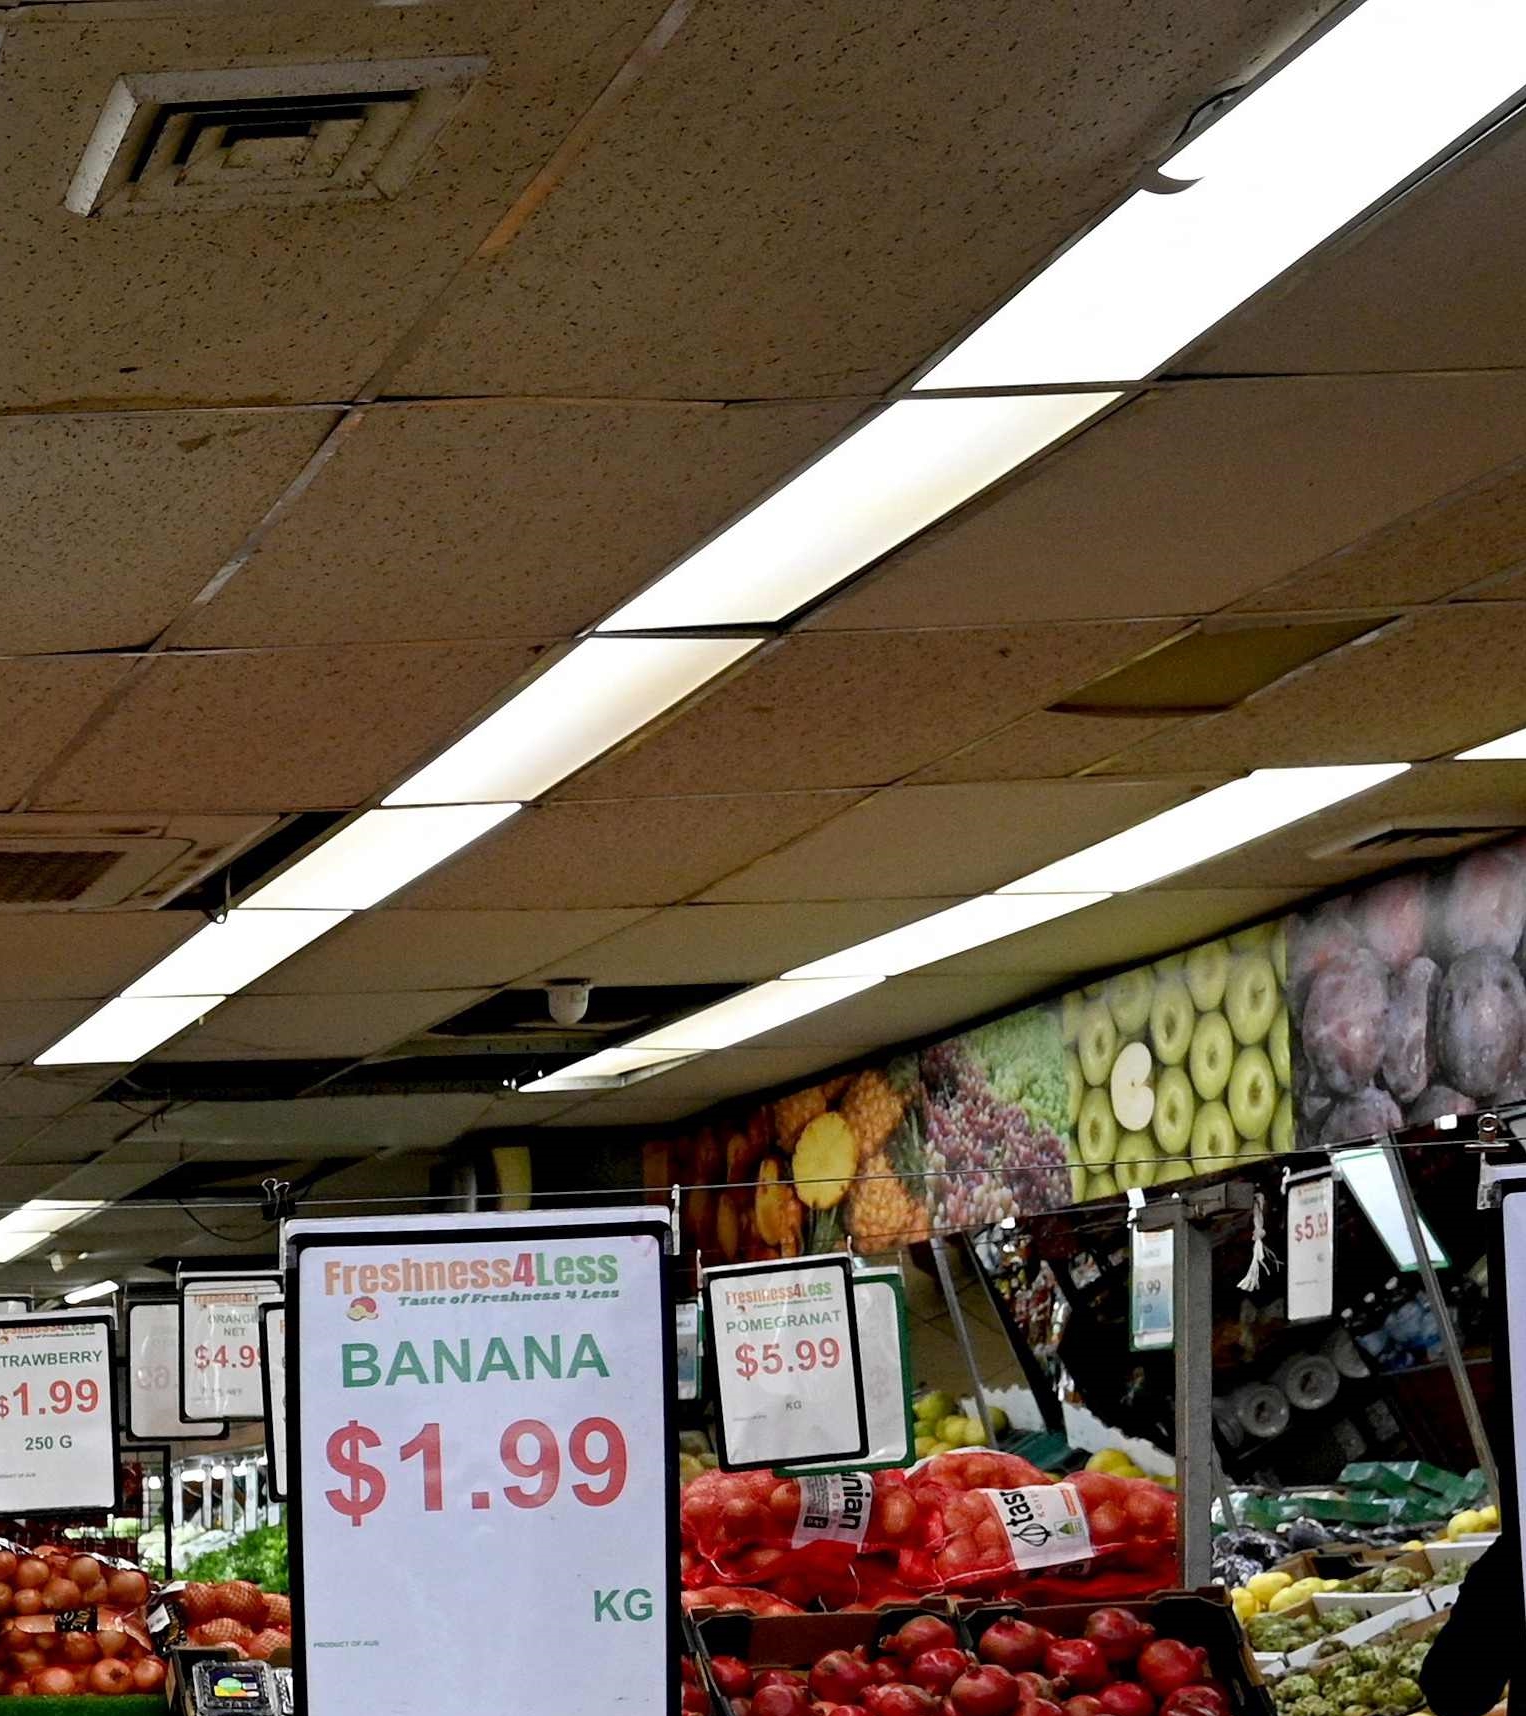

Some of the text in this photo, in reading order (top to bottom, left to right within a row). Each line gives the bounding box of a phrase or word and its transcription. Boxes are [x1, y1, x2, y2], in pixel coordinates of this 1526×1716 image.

[324, 1252, 619, 1296] Freshness4Less
[398, 1288, 620, 1307] Taste of Freshness 4 Less
[725, 1310, 841, 1334] POMEGRANAT
[195, 1344, 262, 1370] $4.9
[341, 1333, 611, 1389] BANANA
[735, 1337, 841, 1381] $5.99
[785, 1401, 802, 1410] KG
[24, 1435, 72, 1450] 250 G
[324, 1417, 628, 1527] $1.99
[593, 1589, 653, 1622] KG
